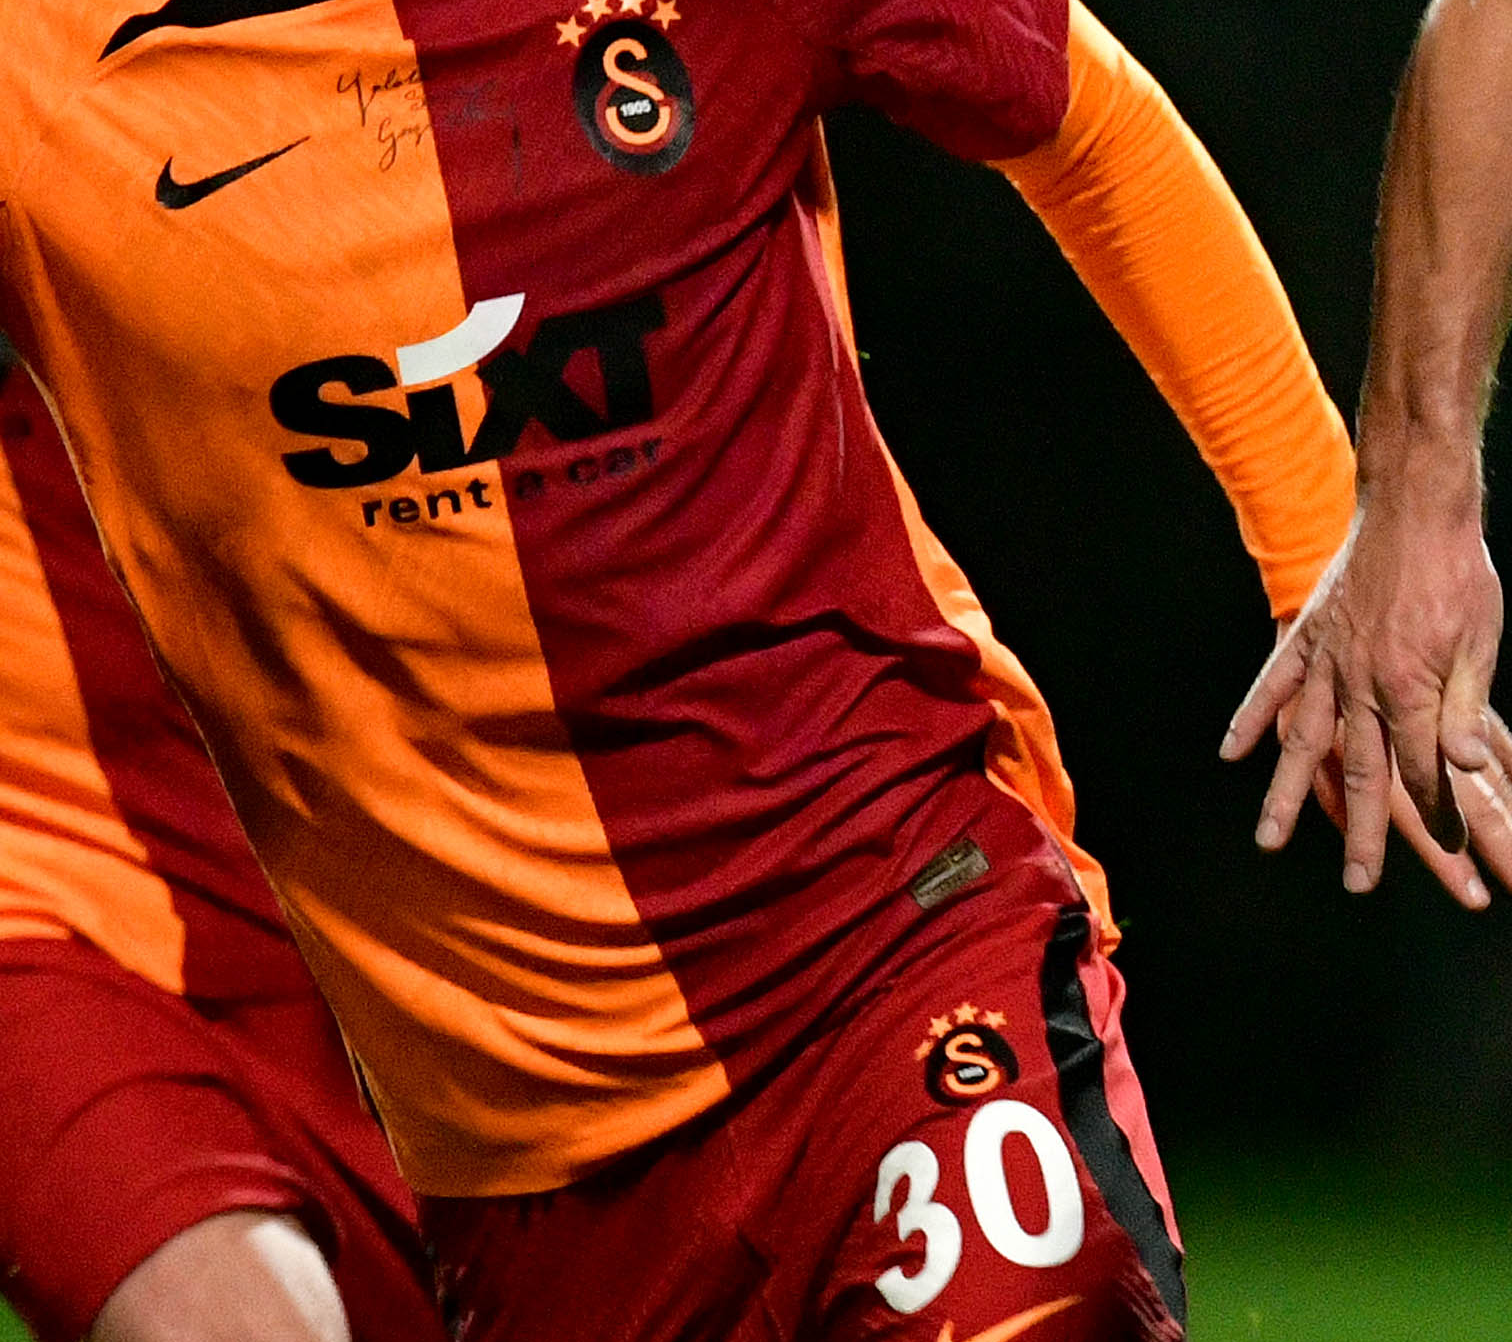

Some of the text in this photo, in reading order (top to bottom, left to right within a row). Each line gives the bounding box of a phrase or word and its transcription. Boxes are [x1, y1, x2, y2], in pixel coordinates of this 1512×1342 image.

[619, 99, 652, 117] 1905
[362, 477, 494, 528] rent
[873, 1098, 1086, 1315] 30
